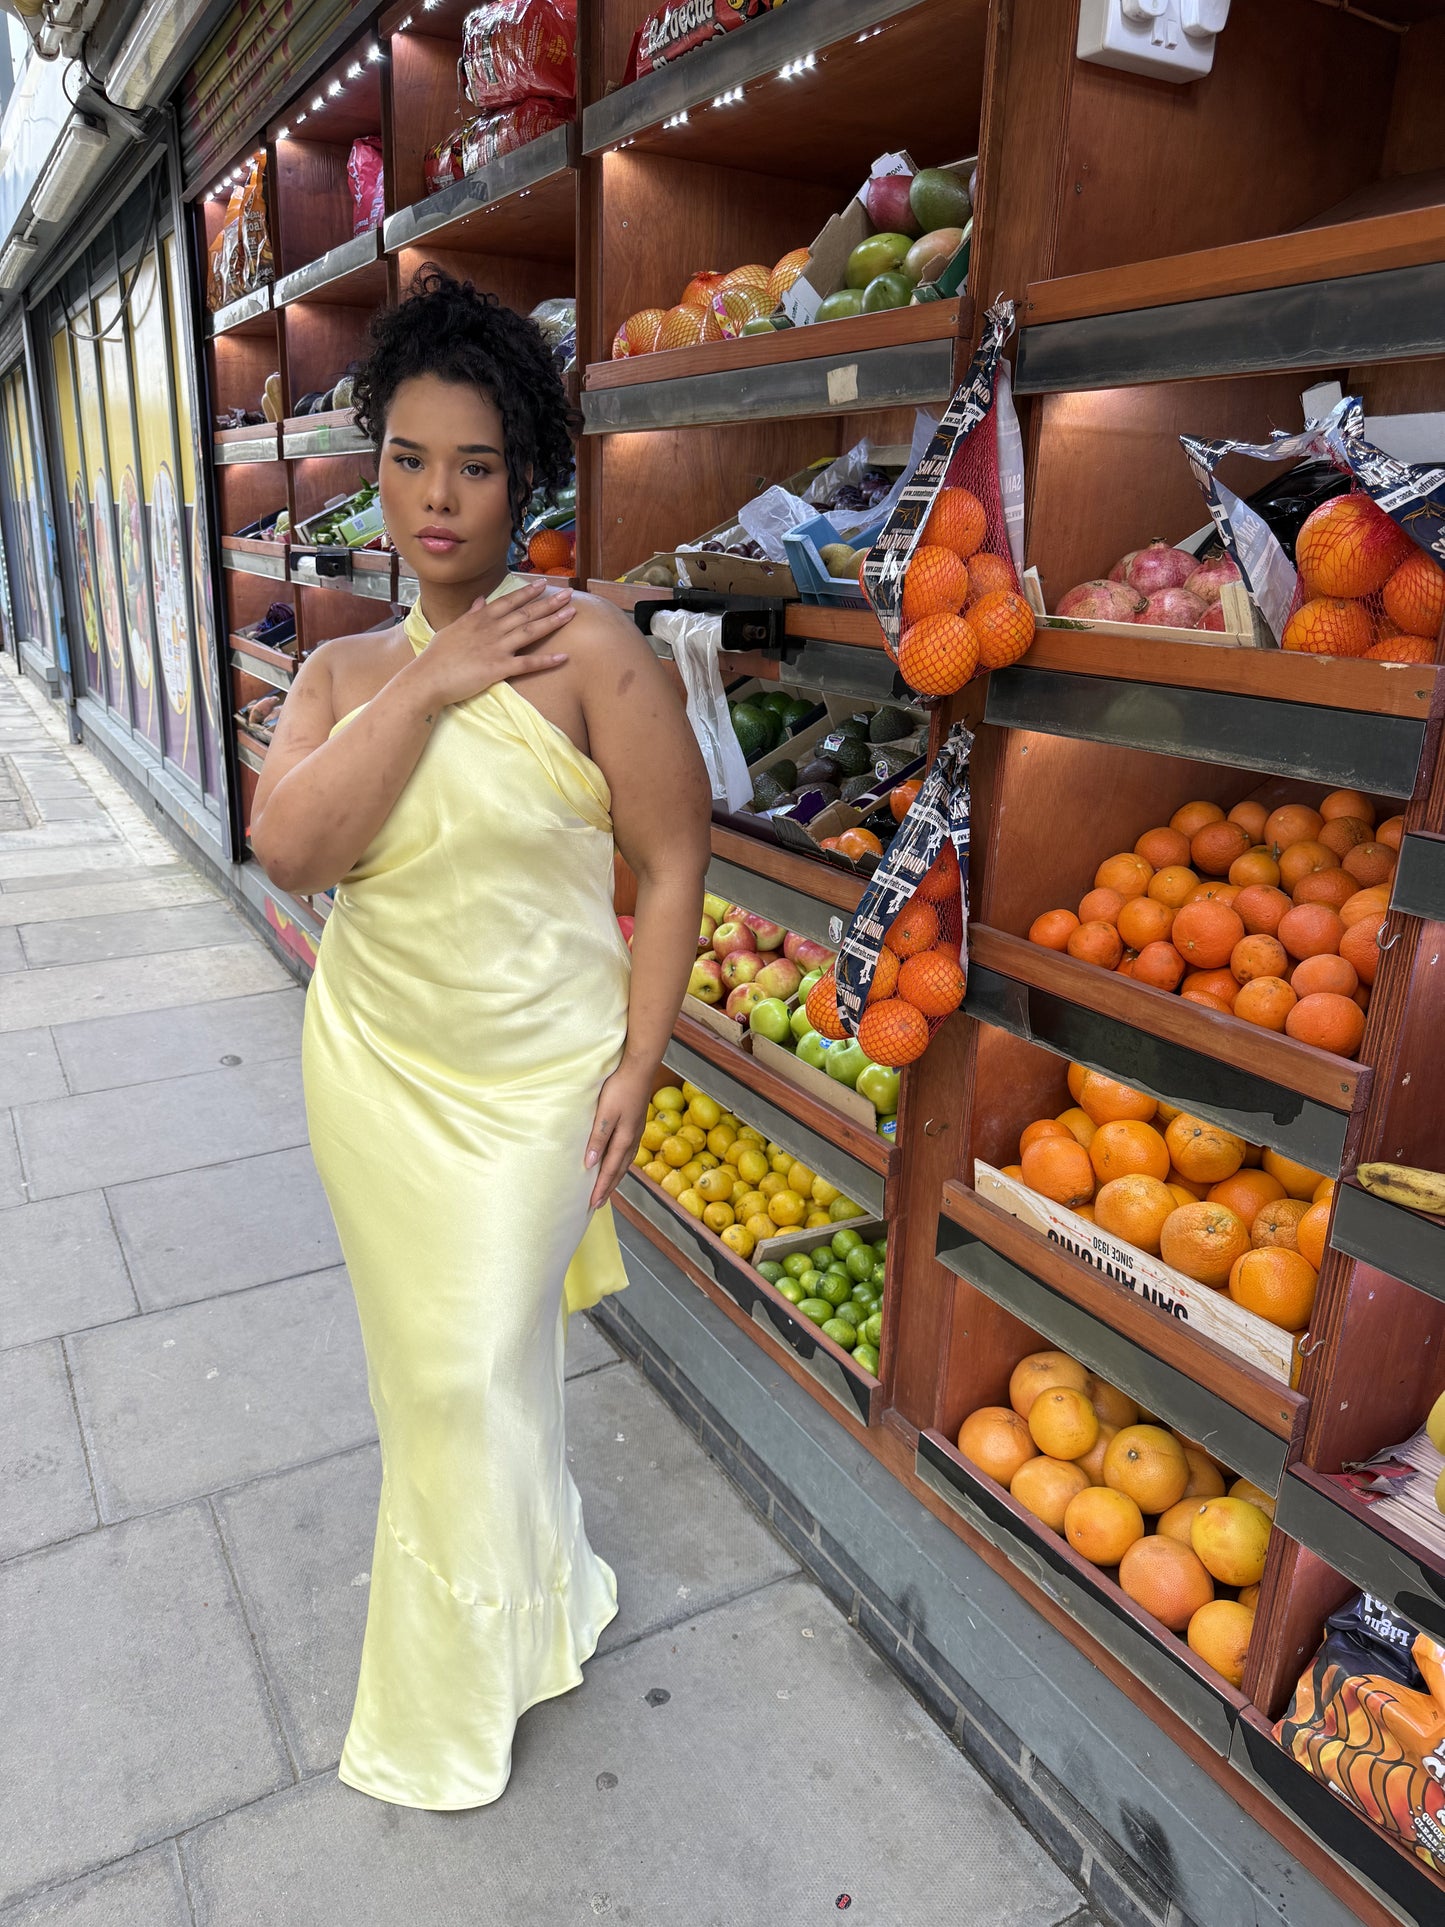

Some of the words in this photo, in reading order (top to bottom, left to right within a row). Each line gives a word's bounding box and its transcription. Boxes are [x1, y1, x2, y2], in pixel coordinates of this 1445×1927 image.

[1093, 1236, 1111, 1256] 1930
[1111, 1247, 1134, 1270] SINCE
[1414, 1816, 1440, 1848] CLEAN
